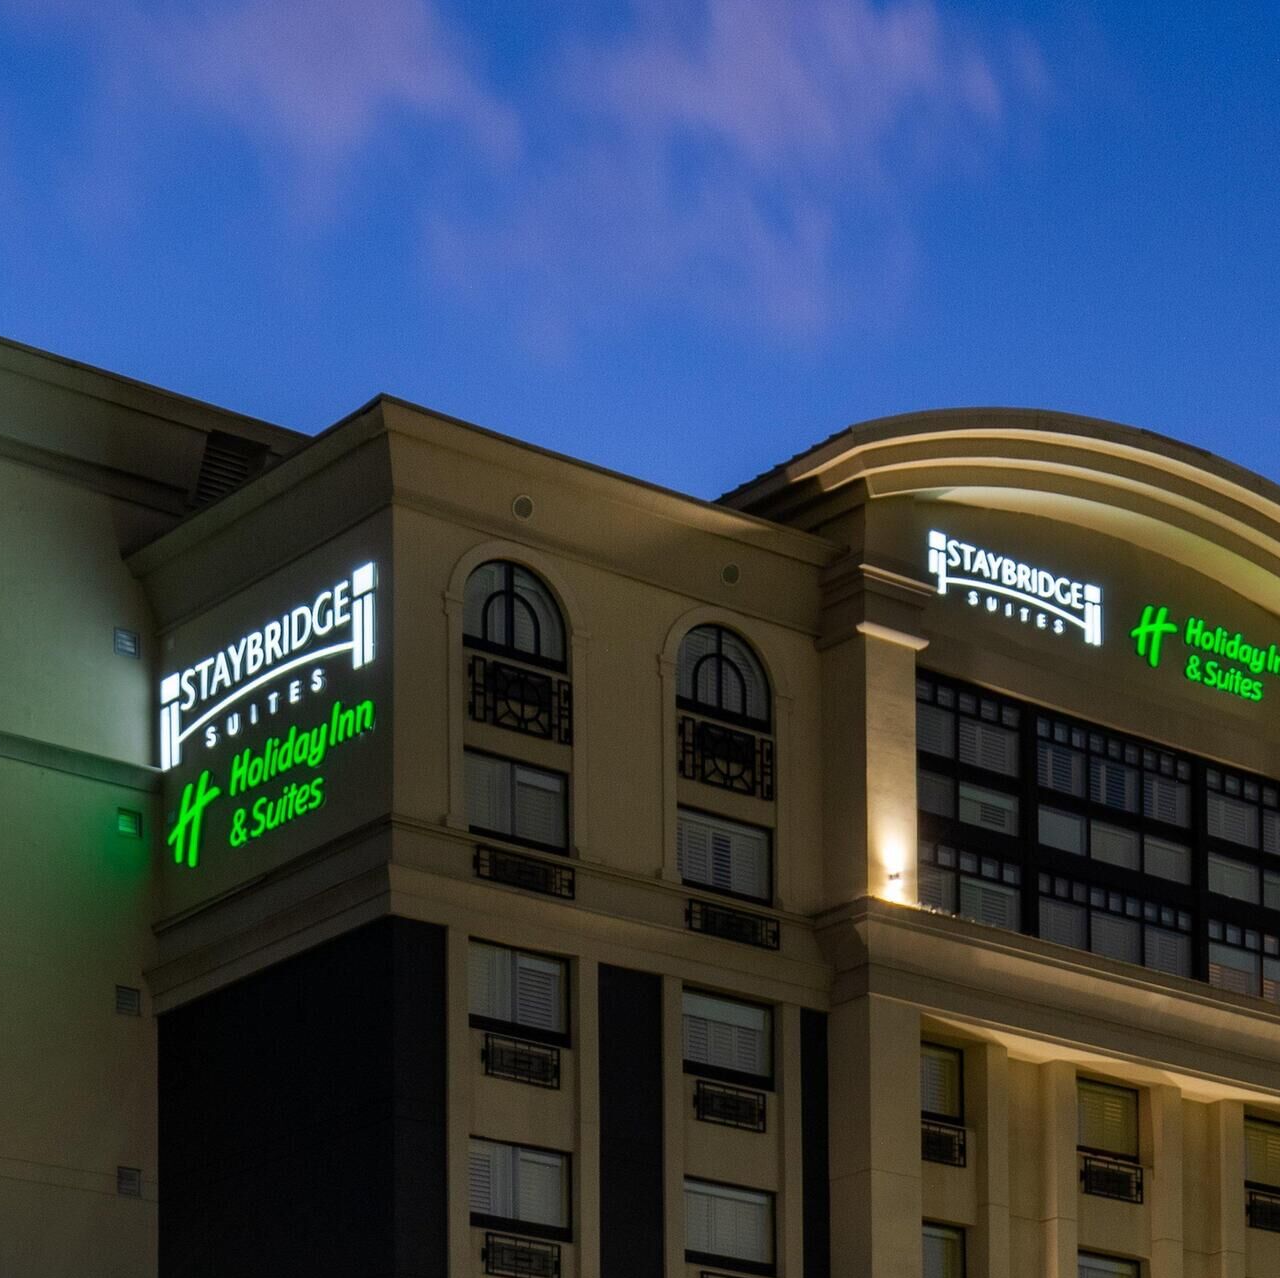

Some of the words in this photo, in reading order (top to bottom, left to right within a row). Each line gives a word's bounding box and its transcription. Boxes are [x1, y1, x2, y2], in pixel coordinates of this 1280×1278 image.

[945, 538, 1086, 610] STAYBRIDGE
[179, 580, 352, 711] STAYBRIDGE
[967, 589, 1065, 635] SUITES
[1183, 616, 1266, 676] Holiday
[205, 667, 327, 749] SUITES
[1204, 660, 1264, 703] Suites
[228, 722, 328, 797] Holiday
[329, 698, 375, 748] Inn
[250, 776, 326, 838] Suites
